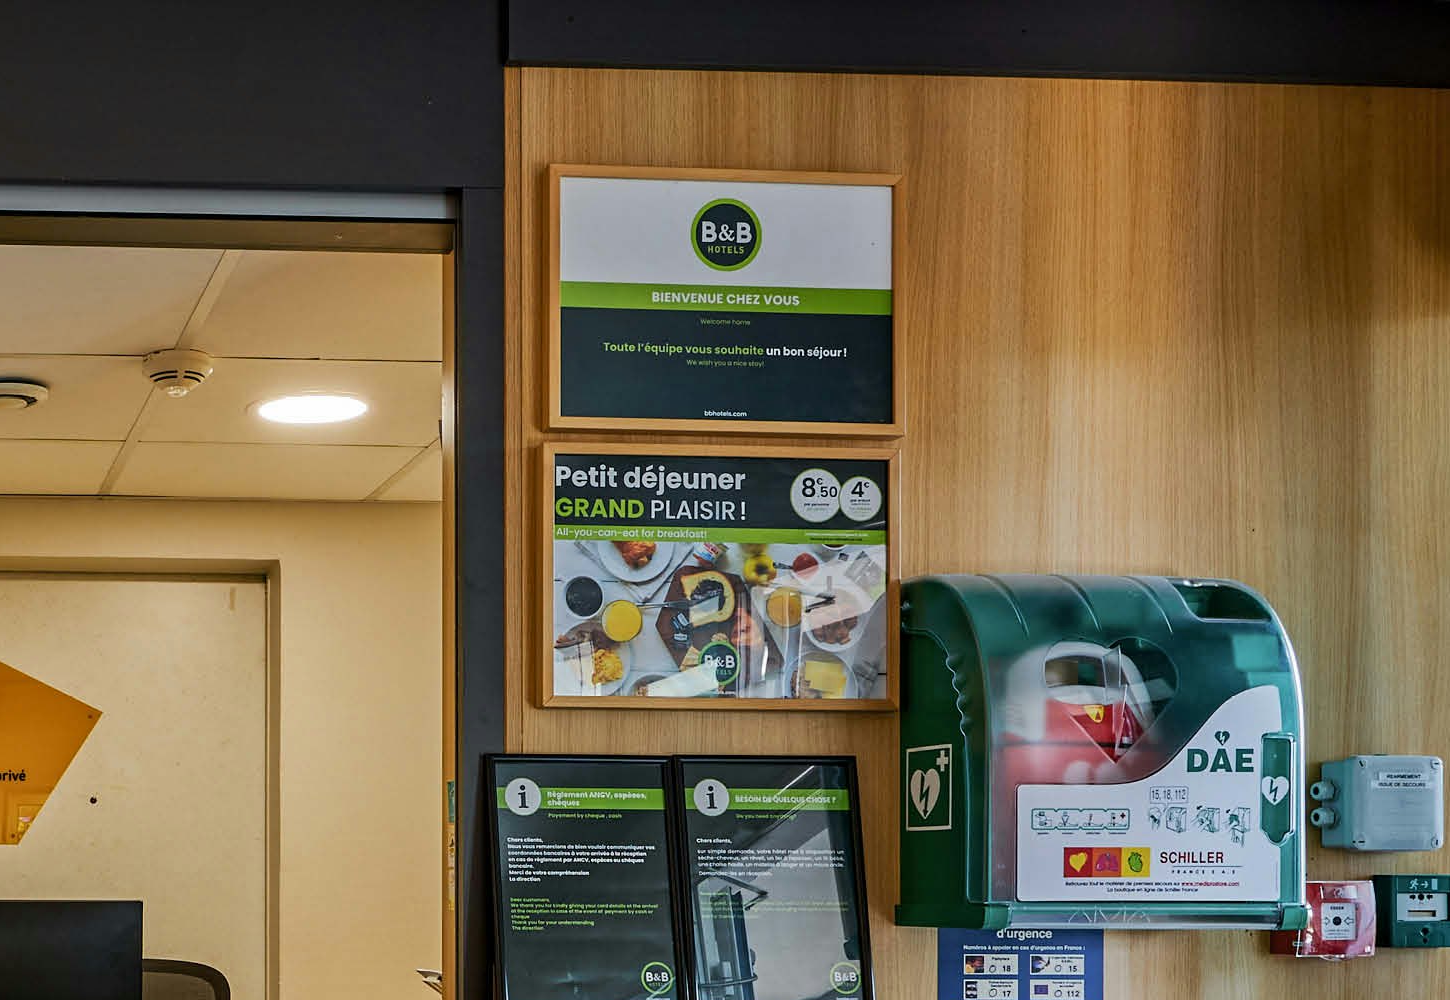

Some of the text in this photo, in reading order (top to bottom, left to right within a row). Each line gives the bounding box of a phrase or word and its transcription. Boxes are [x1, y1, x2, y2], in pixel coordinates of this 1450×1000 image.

[702, 221, 752, 243] B&B
[708, 246, 744, 254] HOTELS
[652, 292, 800, 306] BIENVENUE CHEZ VOUS
[604, 341, 635, 353] Toute
[638, 342, 682, 356] l'équipe
[686, 345, 712, 354] vous
[715, 344, 764, 356] souhaite
[766, 347, 780, 357] un
[783, 347, 804, 357] bon
[704, 410, 747, 418] bbhotels.com
[555, 465, 746, 496] Petit déjeuner
[556, 497, 645, 518] GRAND
[651, 500, 735, 520] PLAISIR
[557, 528, 708, 538] All-you-can-eat for breakfast!
[705, 655, 735, 668] B&B
[1186, 749, 1254, 773] DAE
[1175, 789, 1186, 800] 112
[548, 799, 580, 807] chèques
[1160, 851, 1224, 864] SCHILLER
[997, 929, 1052, 940] d'urgence
[646, 972, 669, 982] B&B
